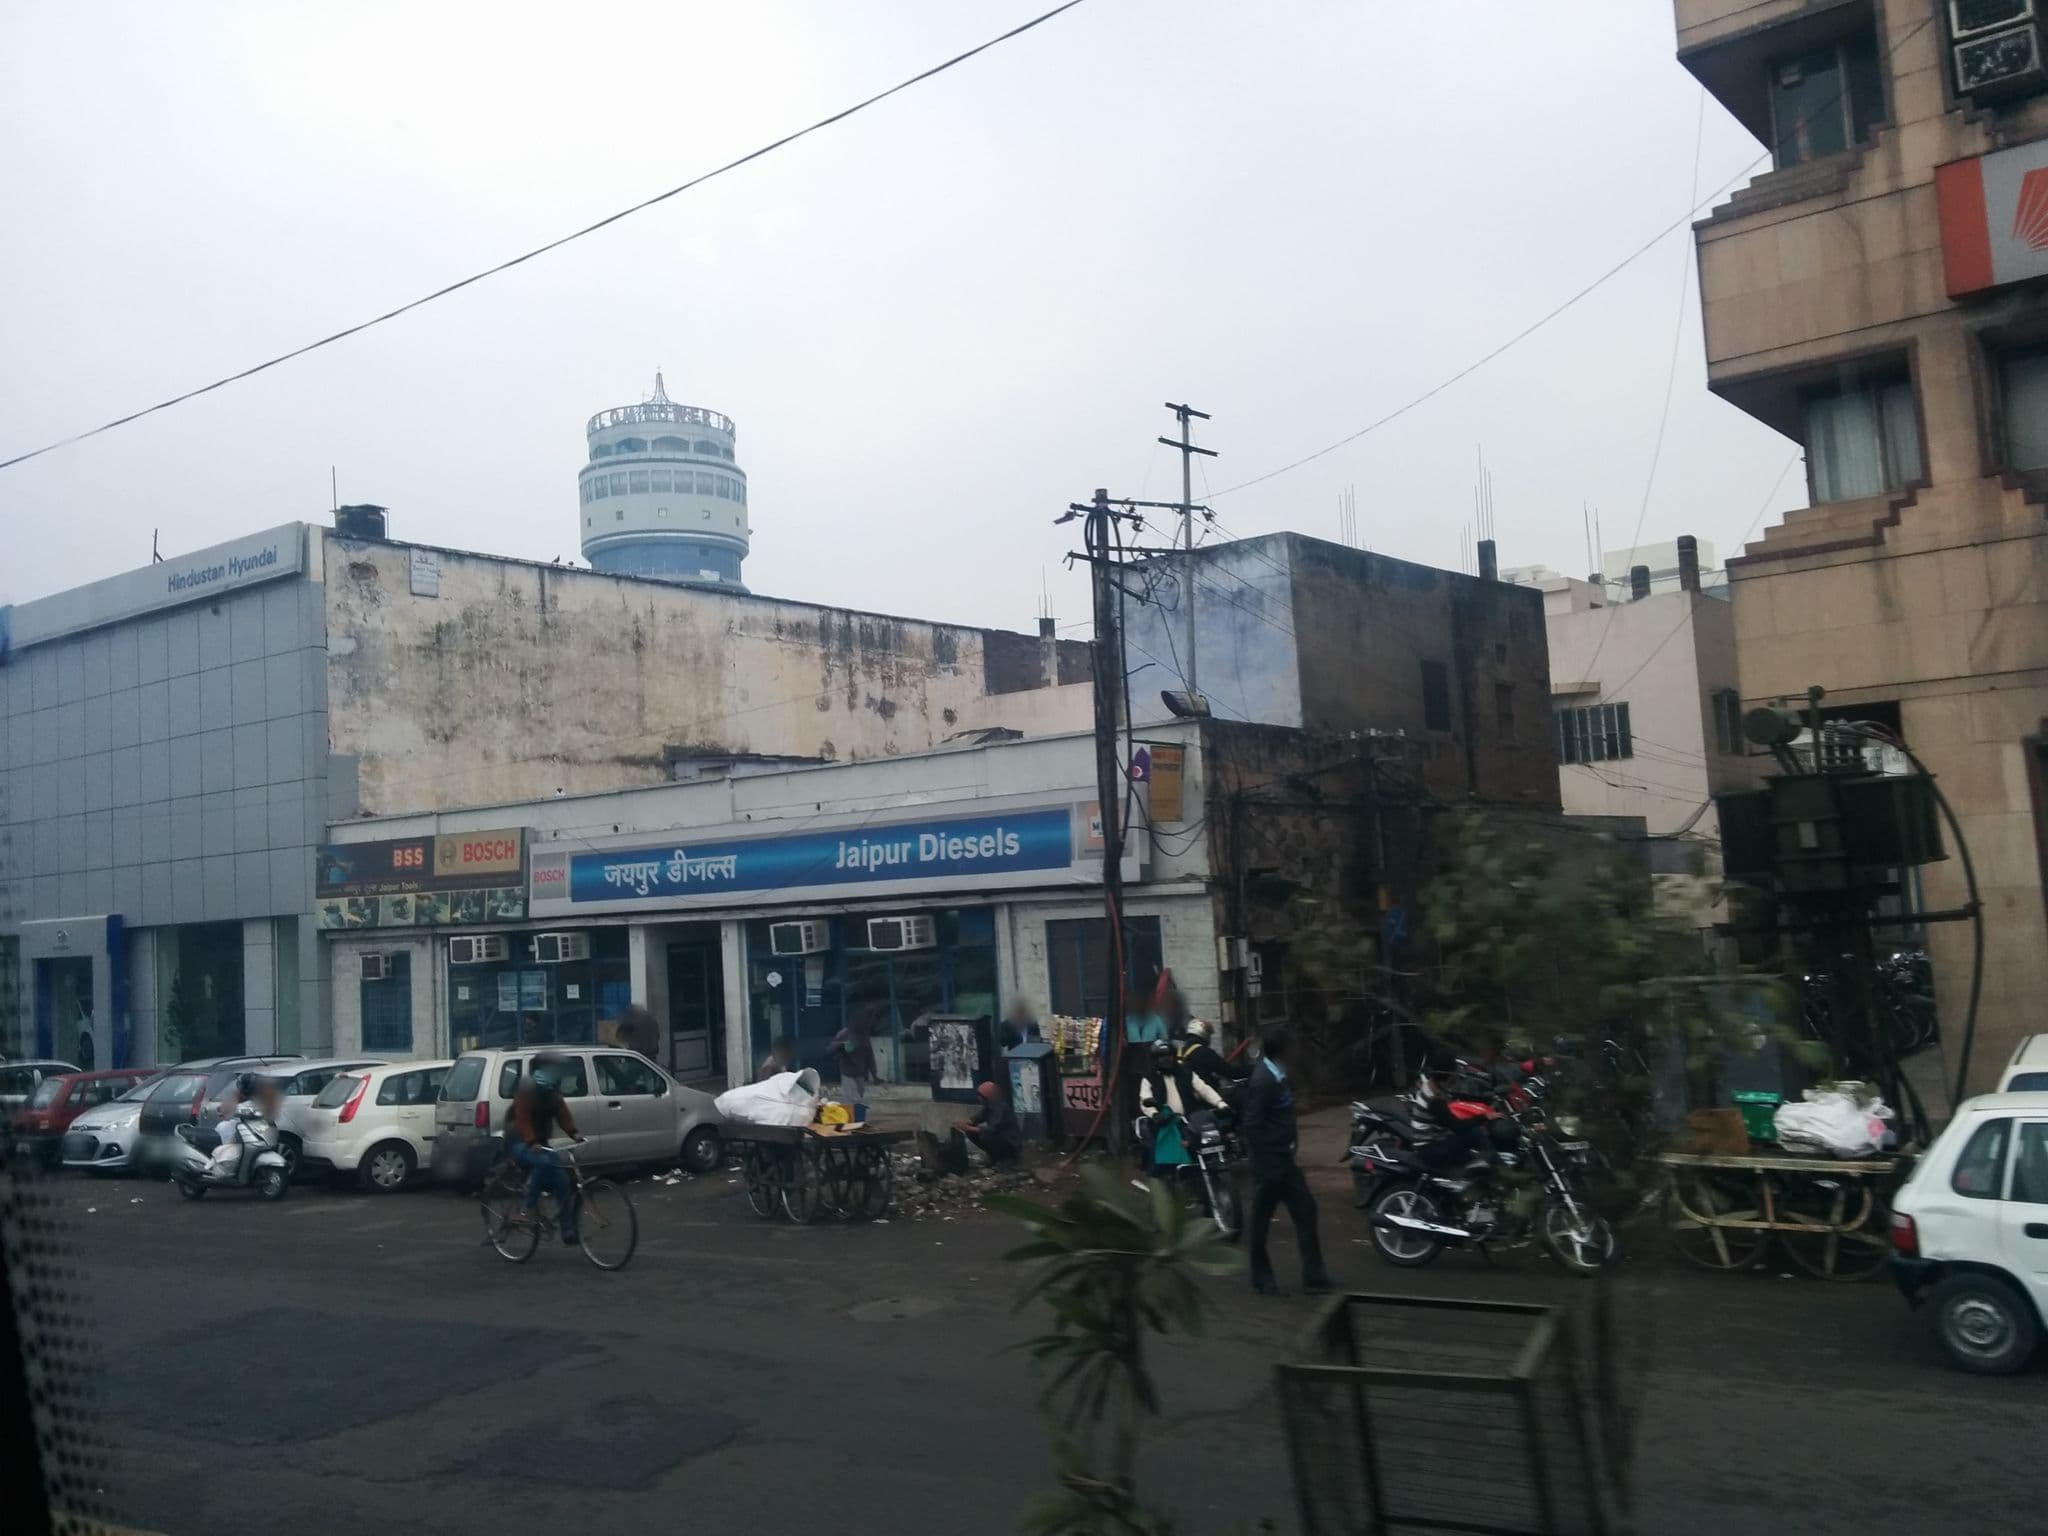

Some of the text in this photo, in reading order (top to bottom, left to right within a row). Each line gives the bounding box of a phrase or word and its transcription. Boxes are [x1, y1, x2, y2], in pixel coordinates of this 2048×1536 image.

[168, 544, 277, 593] Hindustan Hyundai
[392, 847, 424, 868] BSS
[463, 840, 516, 863] BOSCH
[836, 827, 1020, 872] Jaipur Diesels
[534, 868, 565, 883] BOSCH
[604, 849, 738, 895] जयपुर डीजल्स
